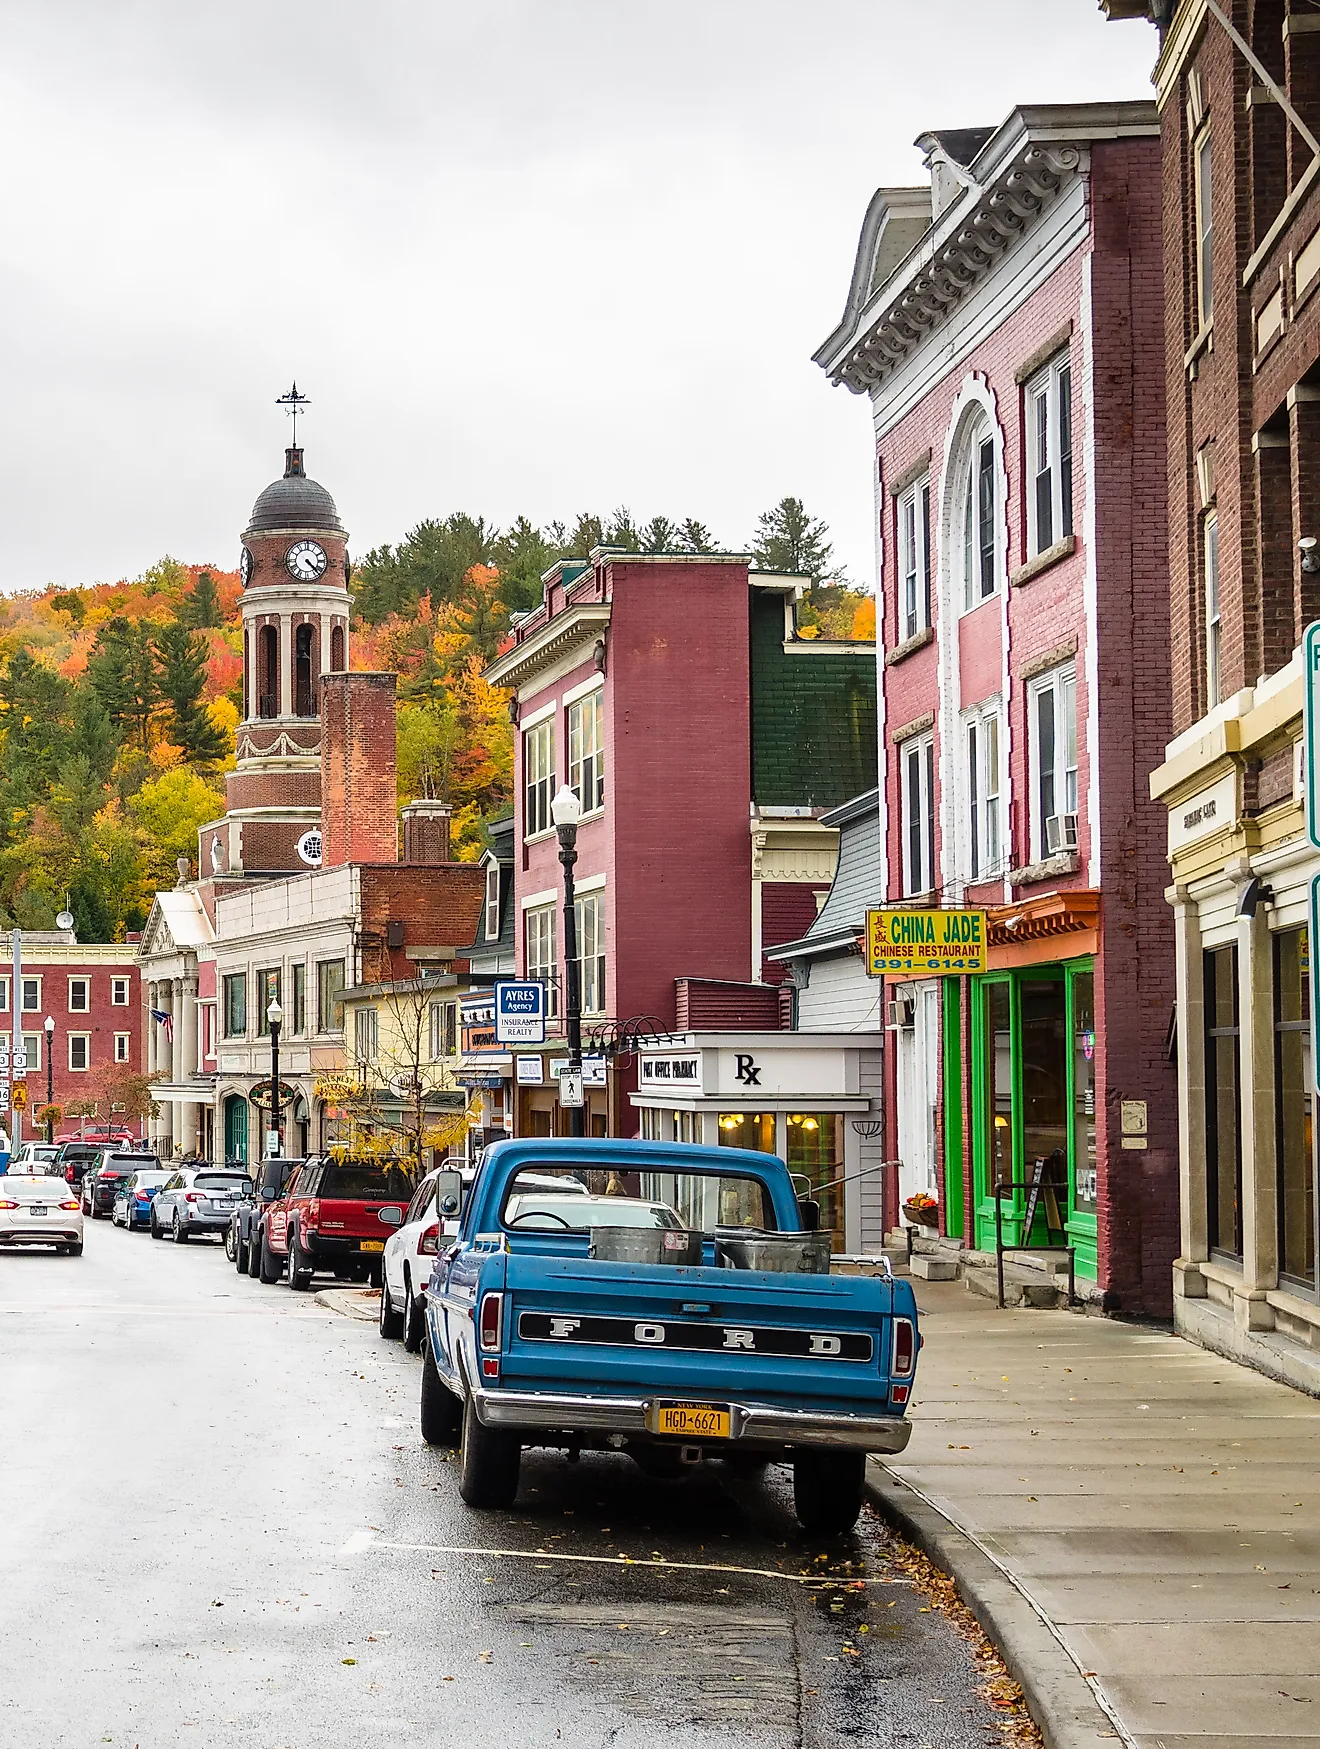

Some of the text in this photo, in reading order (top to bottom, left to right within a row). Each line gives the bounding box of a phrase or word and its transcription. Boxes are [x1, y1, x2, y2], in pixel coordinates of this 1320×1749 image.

[891, 915, 980, 944] CHINA JADE
[873, 945, 981, 957] CHINESE RESTAURANT
[873, 959, 981, 969] 891-6145
[505, 990, 535, 1001] AYRES
[507, 1002, 533, 1012] Agency
[501, 1018, 538, 1027] INSURANCE
[507, 1028, 533, 1036] REALTY
[0, 1056, 6, 1065] 3
[17, 1056, 23, 1065] 3
[733, 1054, 762, 1085] Rx
[549, 1318, 841, 1354] FORD
